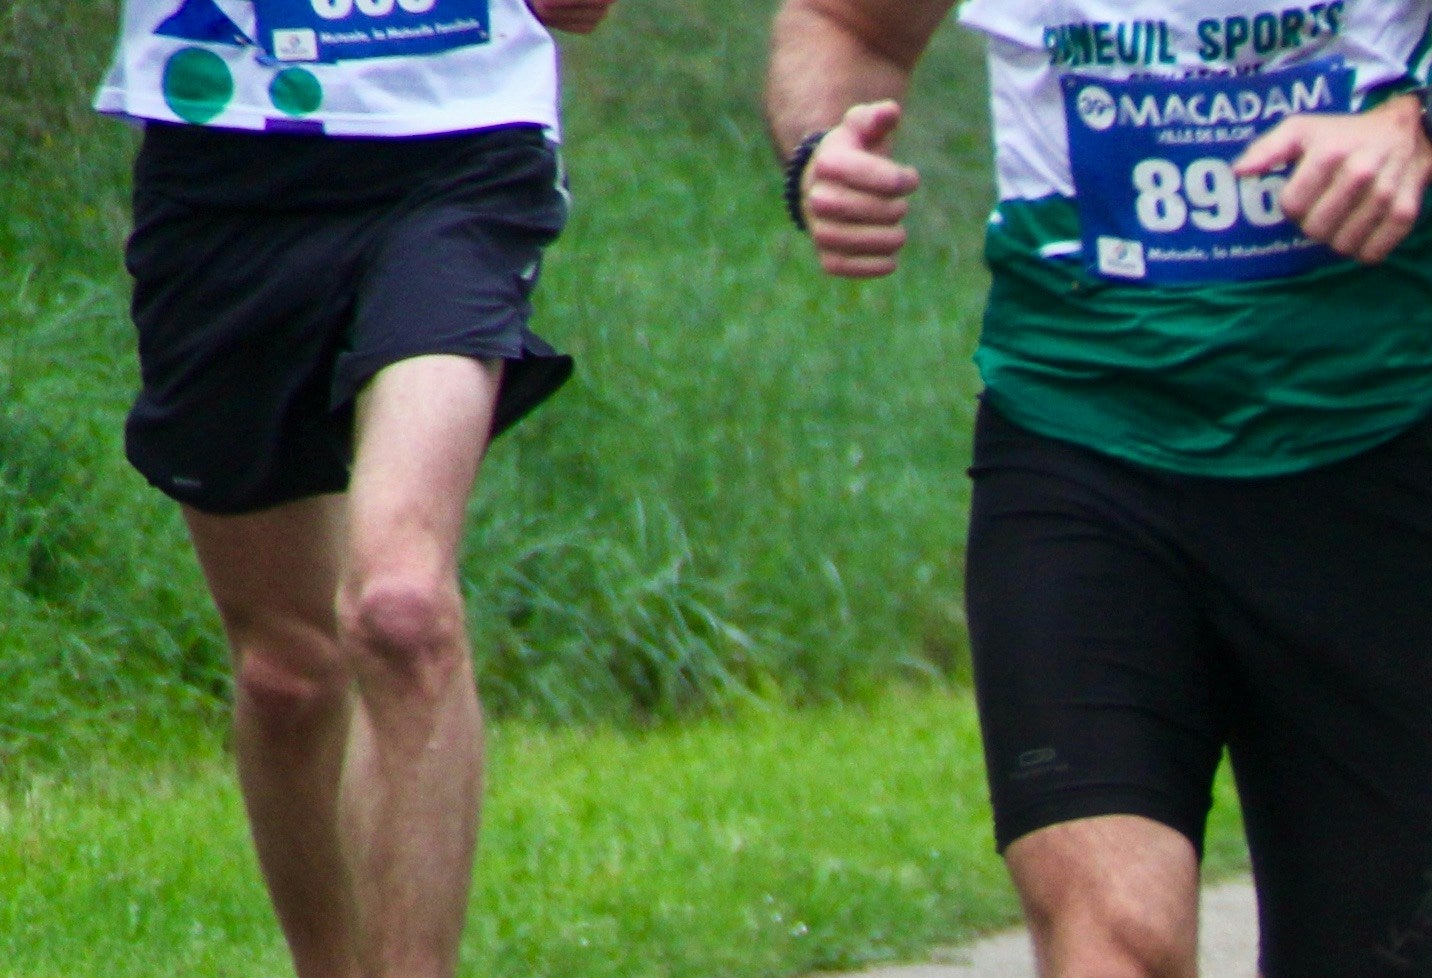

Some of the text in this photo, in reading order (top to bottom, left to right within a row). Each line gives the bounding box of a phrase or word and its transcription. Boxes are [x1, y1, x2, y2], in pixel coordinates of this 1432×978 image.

[1197, 0, 1345, 61] SPORTS
[1118, 75, 1333, 128] MACADAM
[1132, 157, 1288, 233] 896
